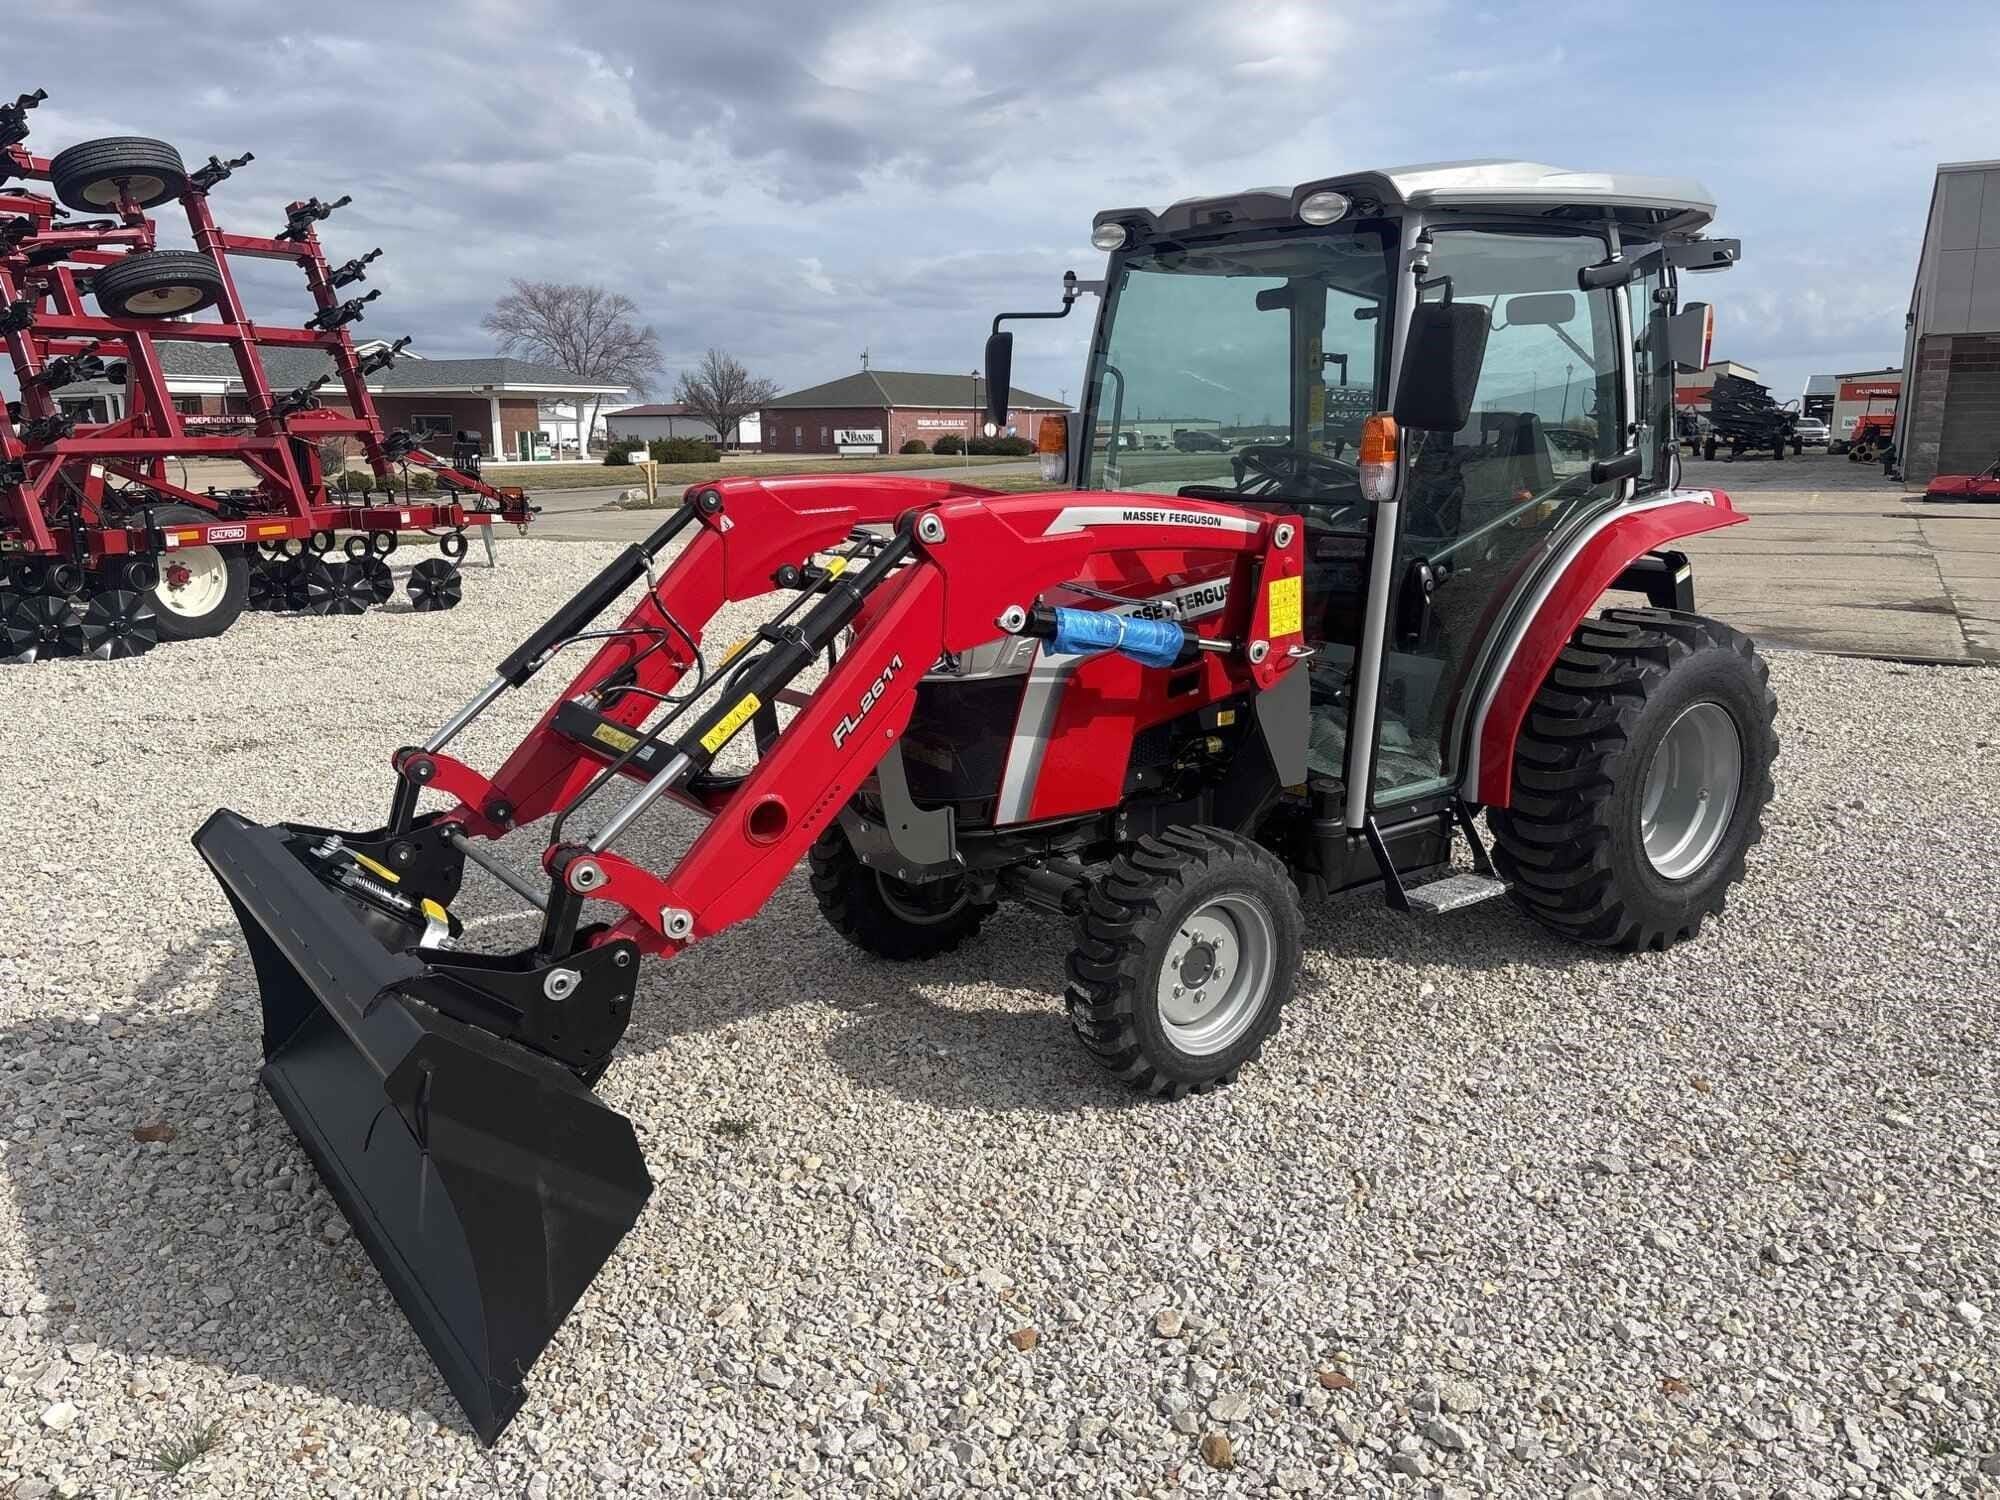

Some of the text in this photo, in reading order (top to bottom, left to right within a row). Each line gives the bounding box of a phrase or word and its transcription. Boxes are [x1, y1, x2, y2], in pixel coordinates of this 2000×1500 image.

[185, 416, 235, 424] INDEPENDENT
[1122, 511, 1222, 526] MASSEY FERGUSON
[211, 528, 244, 540] SALFORD
[832, 654, 904, 750] FL.2611
